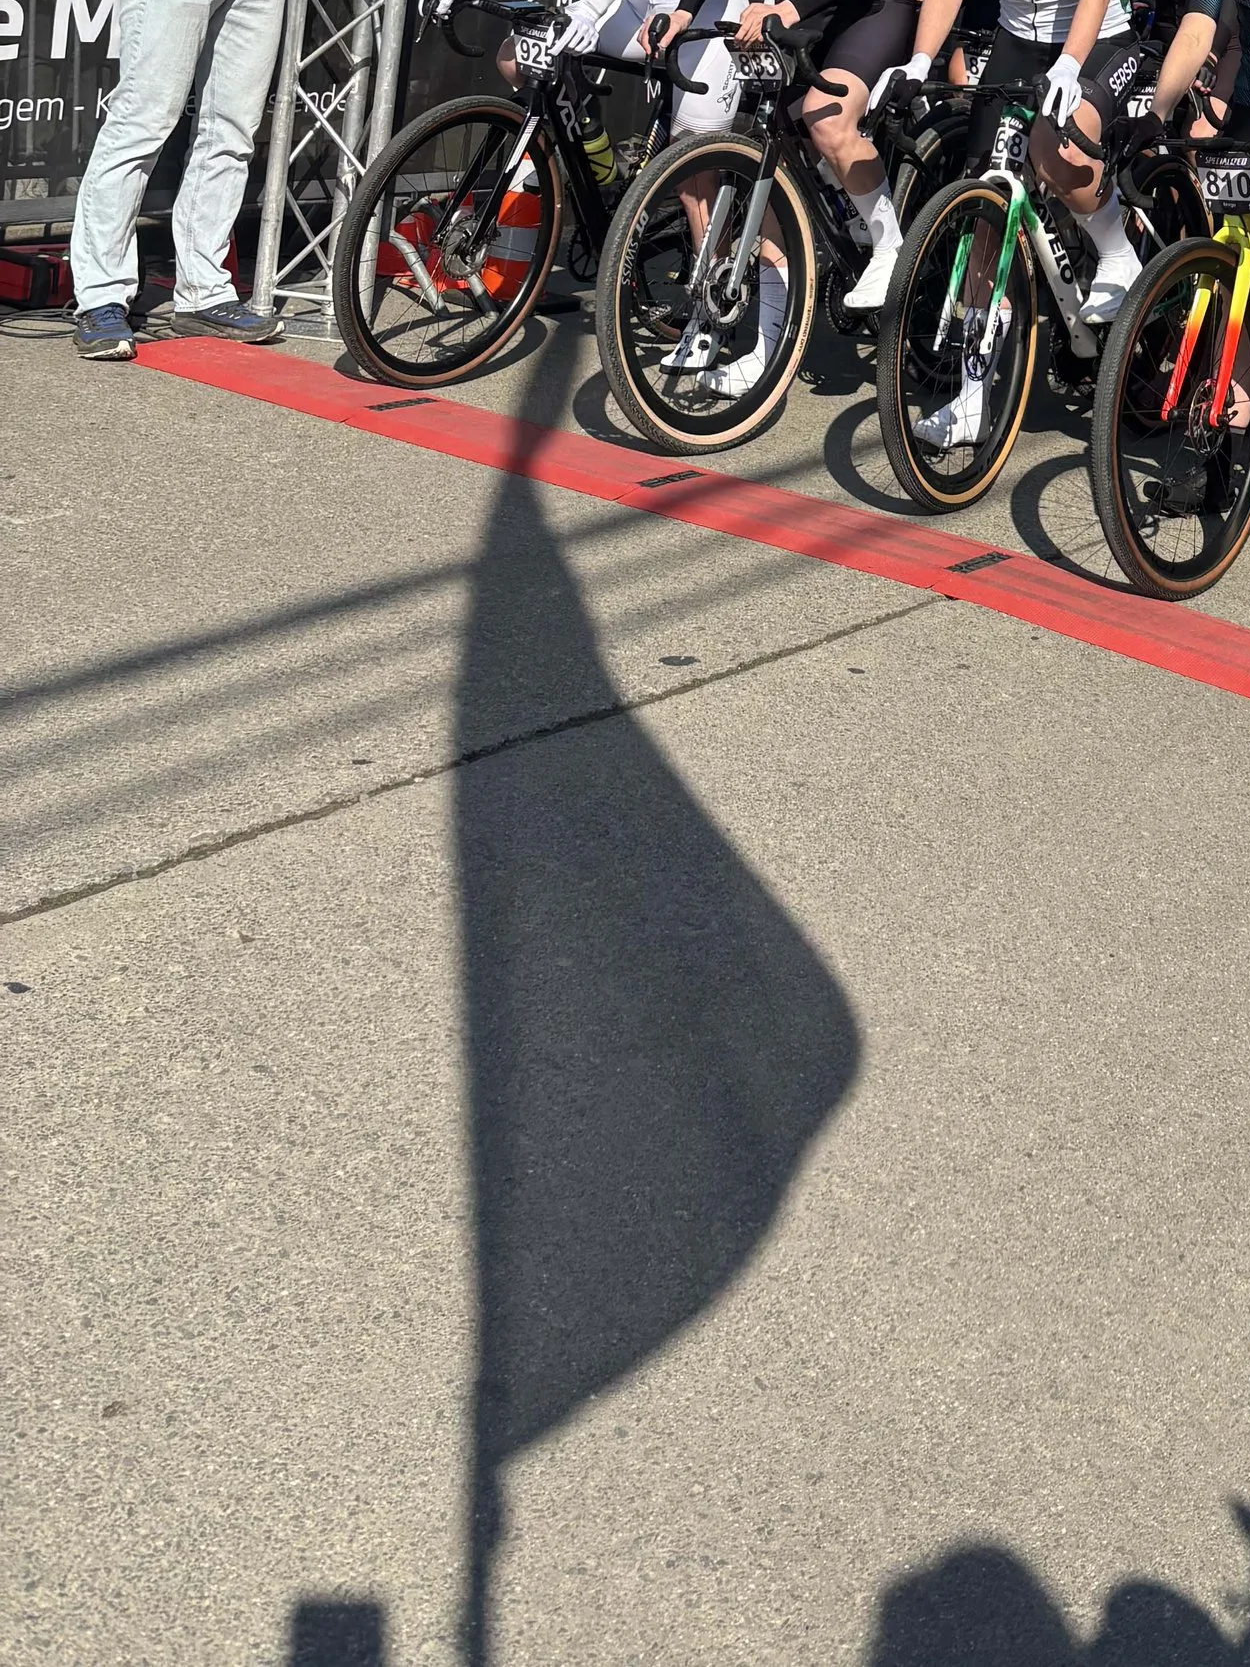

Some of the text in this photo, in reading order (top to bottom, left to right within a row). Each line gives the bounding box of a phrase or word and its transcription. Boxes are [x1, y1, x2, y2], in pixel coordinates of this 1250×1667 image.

[520, 38, 555, 68] 925
[1108, 56, 1138, 97] SERSO
[621, 239, 640, 287] SWISS
